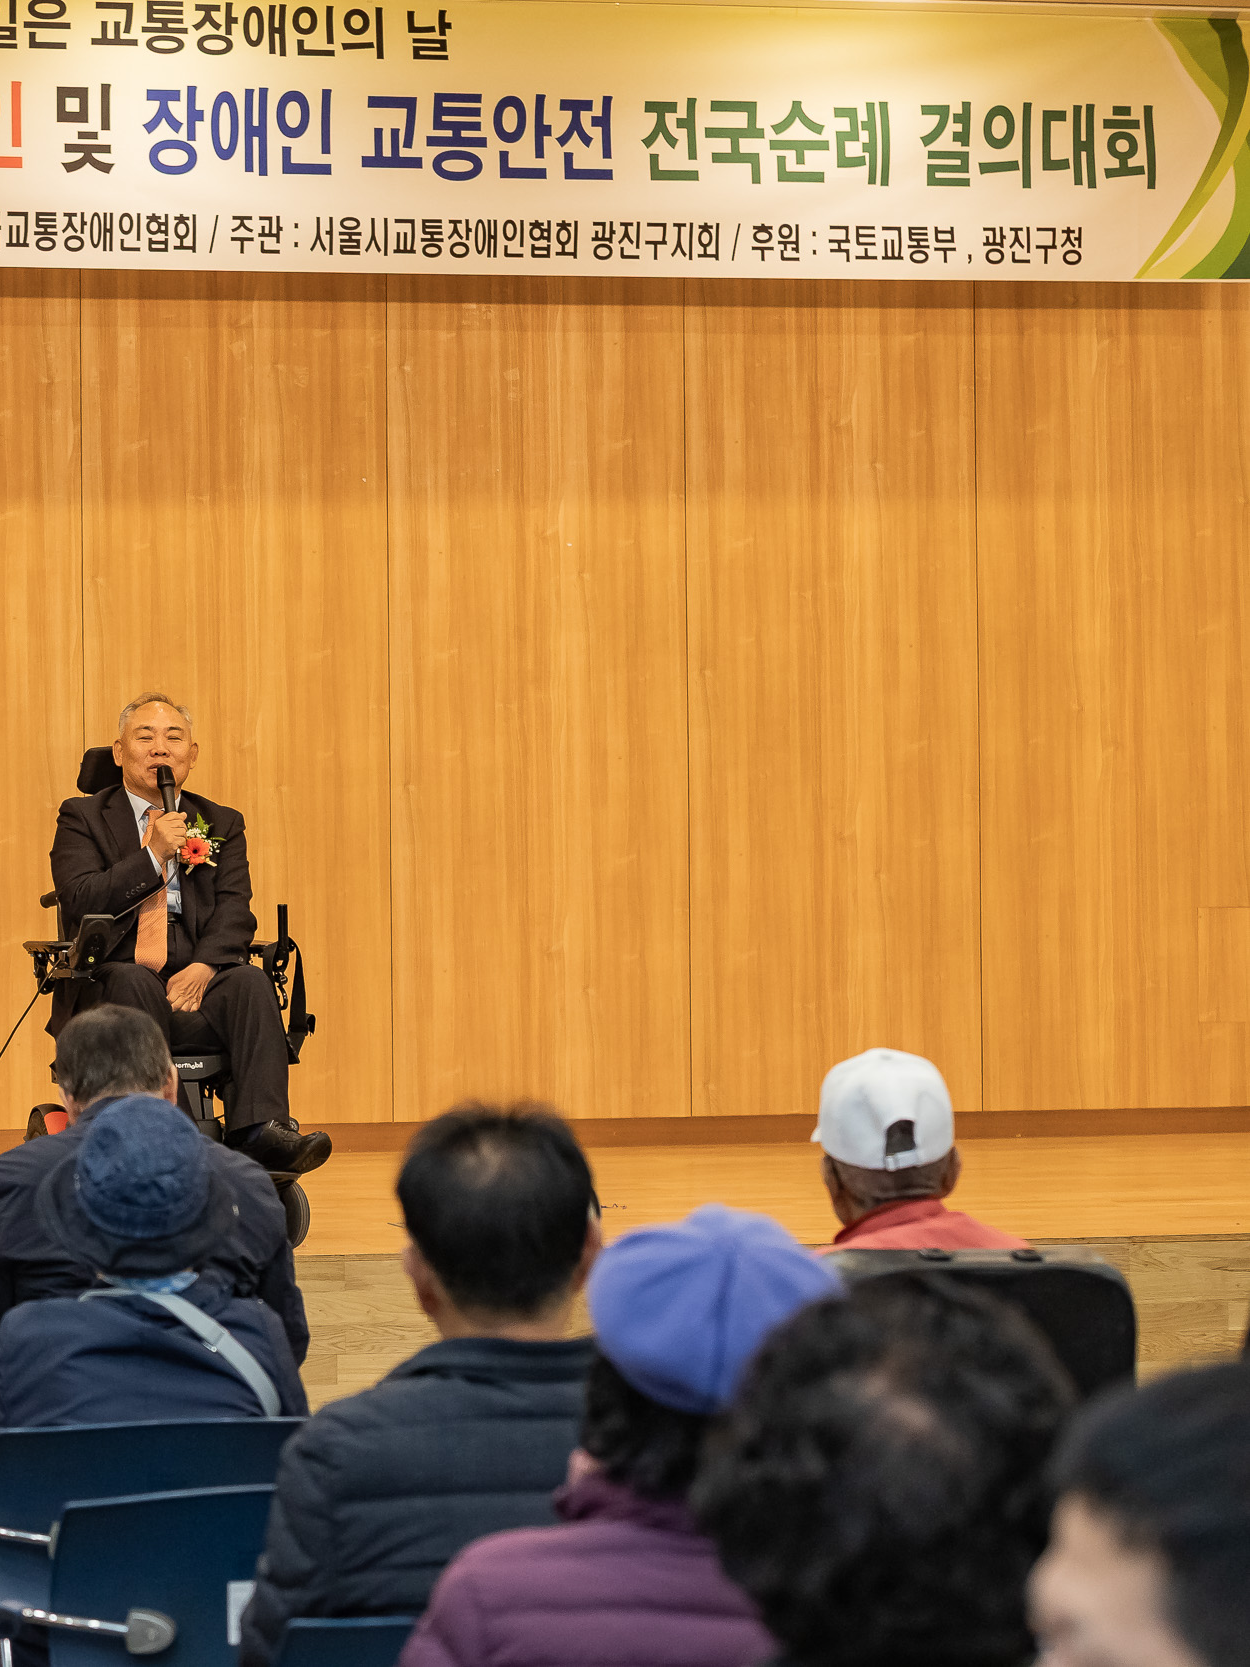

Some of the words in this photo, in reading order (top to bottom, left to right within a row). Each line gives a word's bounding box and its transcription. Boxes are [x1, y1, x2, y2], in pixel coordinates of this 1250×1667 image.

[90, 0, 385, 60] 교통장애인의
[406, 9, 453, 61] 날
[56, 83, 115, 175] 및
[143, 85, 333, 177] 장애인
[361, 92, 614, 182] 교통안전
[642, 97, 891, 187] 전국순례
[920, 101, 1157, 190] 결의대회
[230, 215, 284, 255] 주관
[310, 216, 579, 260] 서울시교통장애인협회
[590, 220, 720, 262] 광진구지회
[751, 223, 800, 262] 후원
[828, 225, 957, 265] 국토교통부
[982, 226, 1083, 266] 광진구청
